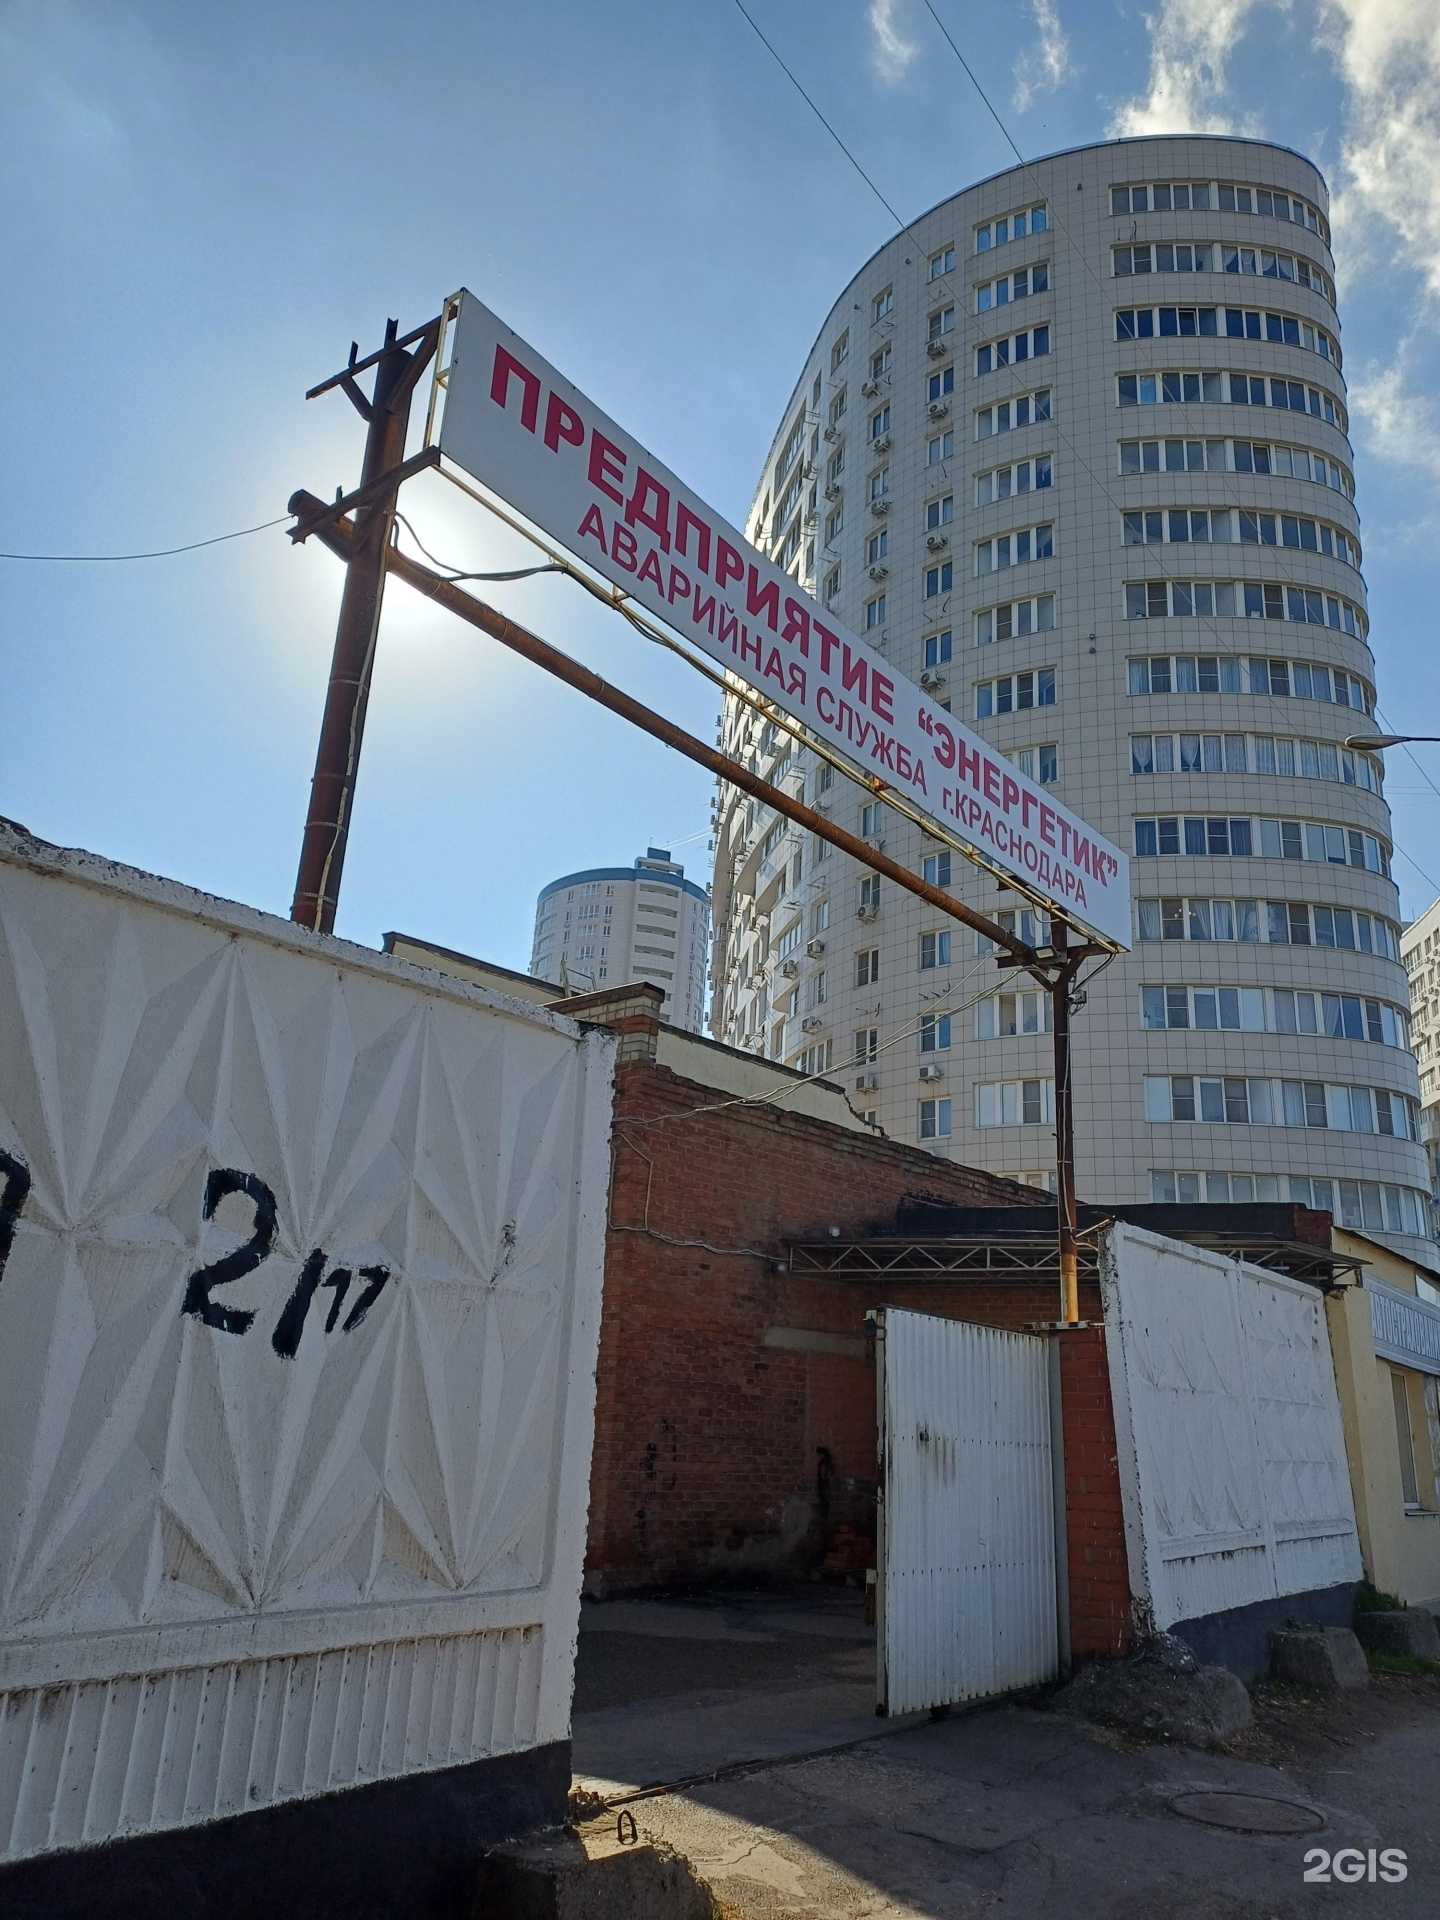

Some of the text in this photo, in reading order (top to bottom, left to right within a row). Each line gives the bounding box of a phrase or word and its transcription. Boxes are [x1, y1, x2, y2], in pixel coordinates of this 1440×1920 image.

[489, 342, 895, 725] ПРЕДПРИЯТИЕ
[576, 502, 807, 706] АВАРИЙНАЯ
[815, 686, 928, 797] СЛУЖБА
[1369, 1291, 1440, 1361] АВТОСТРАХОВАНИ
